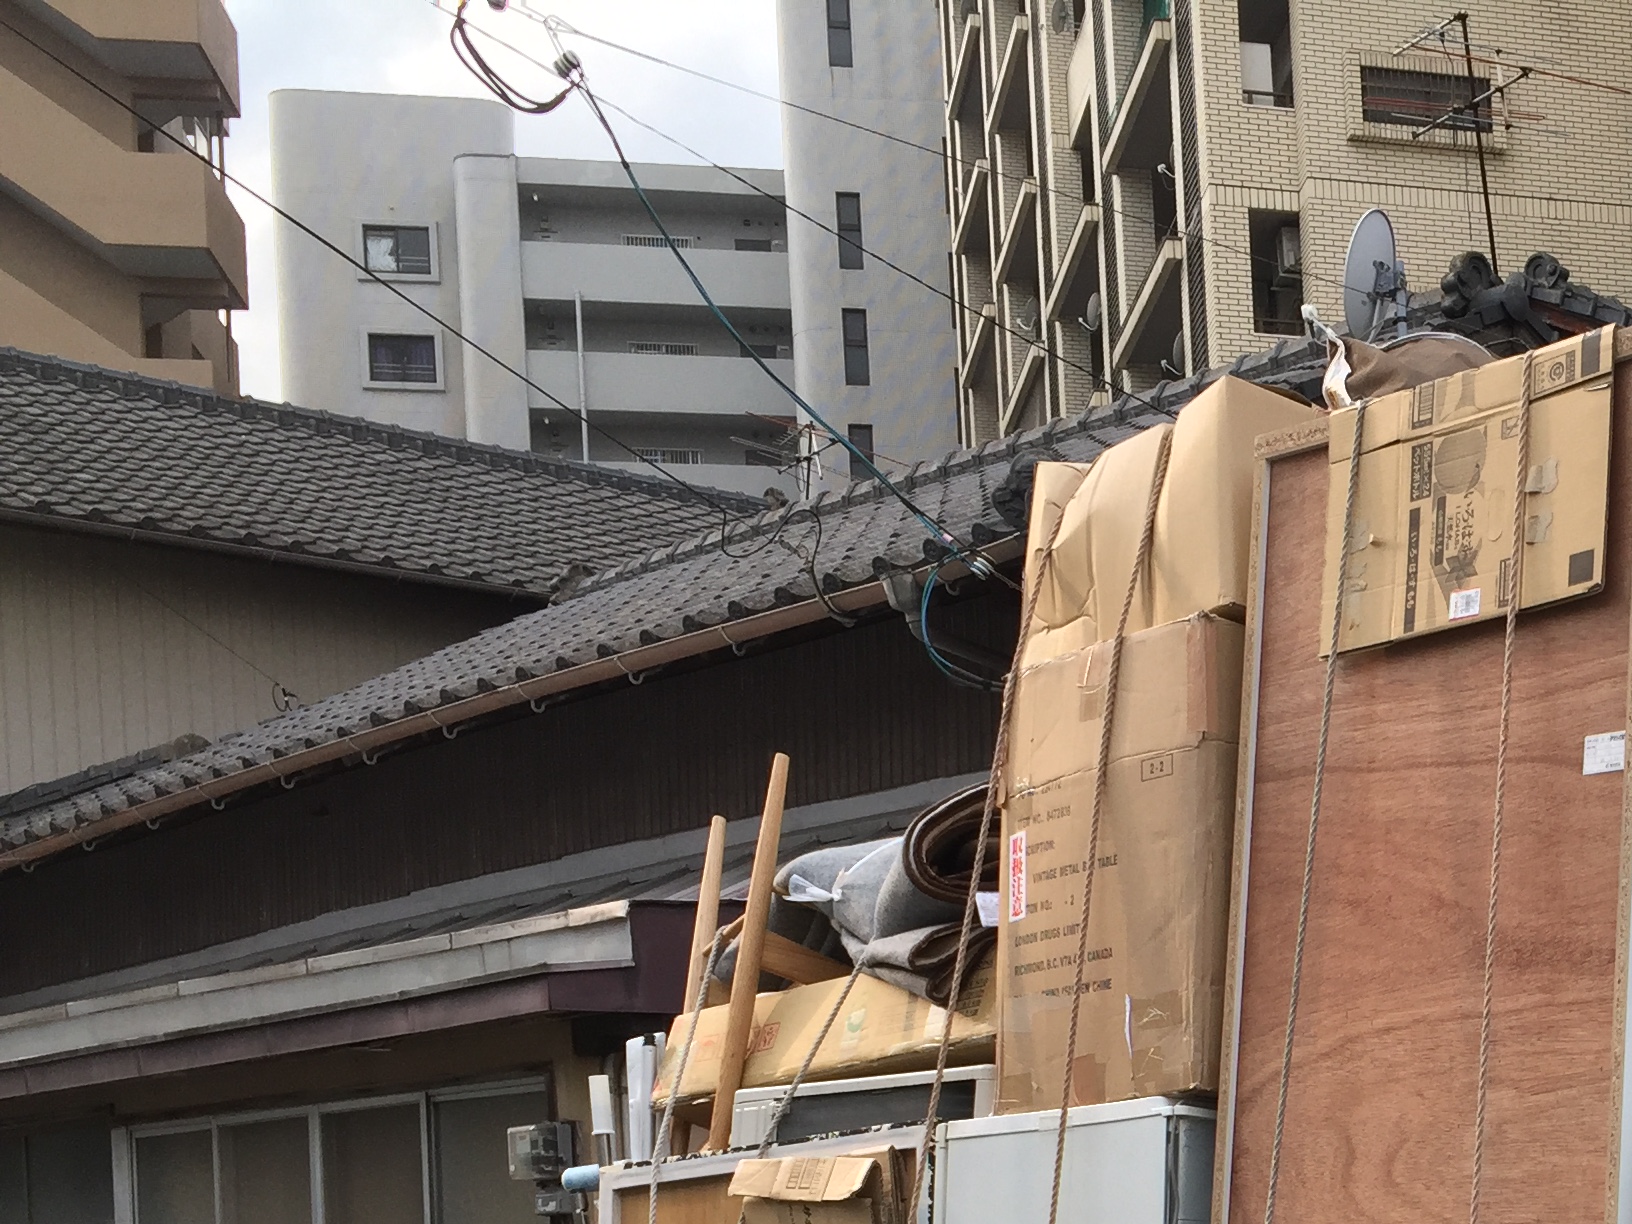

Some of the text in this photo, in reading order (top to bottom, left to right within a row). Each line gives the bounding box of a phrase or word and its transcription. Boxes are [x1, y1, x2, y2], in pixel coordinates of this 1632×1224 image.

[1411, 447, 1422, 500] ペットボトル
[1150, 760, 1164, 774] 2-2
[1011, 837, 1024, 917] 取扱注意
[1033, 867, 1058, 883] VINTAGE
[1060, 862, 1080, 877] METAL
[1097, 854, 1118, 868] TABLE
[1014, 932, 1038, 947] LONDON
[1040, 927, 1060, 941] DRUGS
[1087, 947, 1113, 962] CANADA
